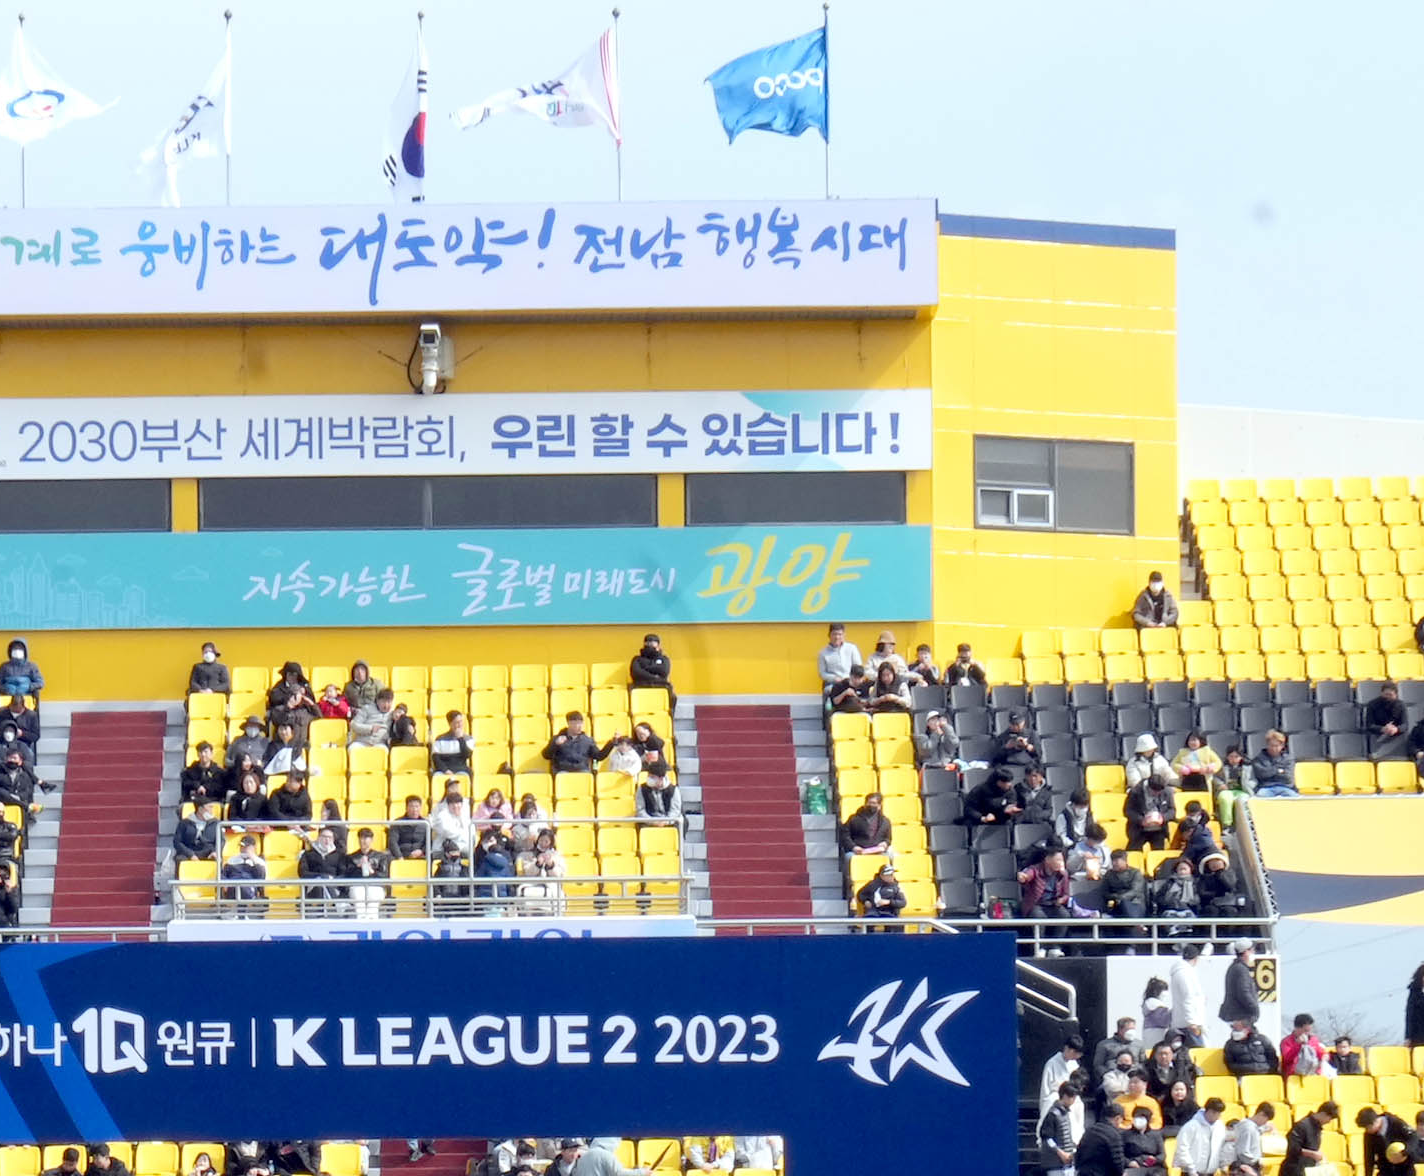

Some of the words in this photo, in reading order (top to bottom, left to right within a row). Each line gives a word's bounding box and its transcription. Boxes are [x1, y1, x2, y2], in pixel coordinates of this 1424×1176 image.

[119, 220, 297, 290] 웅비하는
[319, 207, 557, 306] 대도약!
[573, 216, 686, 273] 전남
[17, 417, 227, 464] 2030부산
[240, 413, 466, 463] 세계박람회,
[491, 413, 576, 458] 우린
[590, 413, 634, 458] 할
[646, 414, 688, 457] 수
[242, 559, 427, 614] 지속가능한
[452, 543, 557, 618] 글로벌
[563, 564, 675, 600] 미래도시
[696, 533, 870, 617] 광양
[156, 1020, 236, 1067] 원큐
[273, 1017, 328, 1067] K
[339, 1014, 591, 1067] LEAGUE
[601, 1014, 638, 1064] 2
[654, 1014, 780, 1064] 2023
